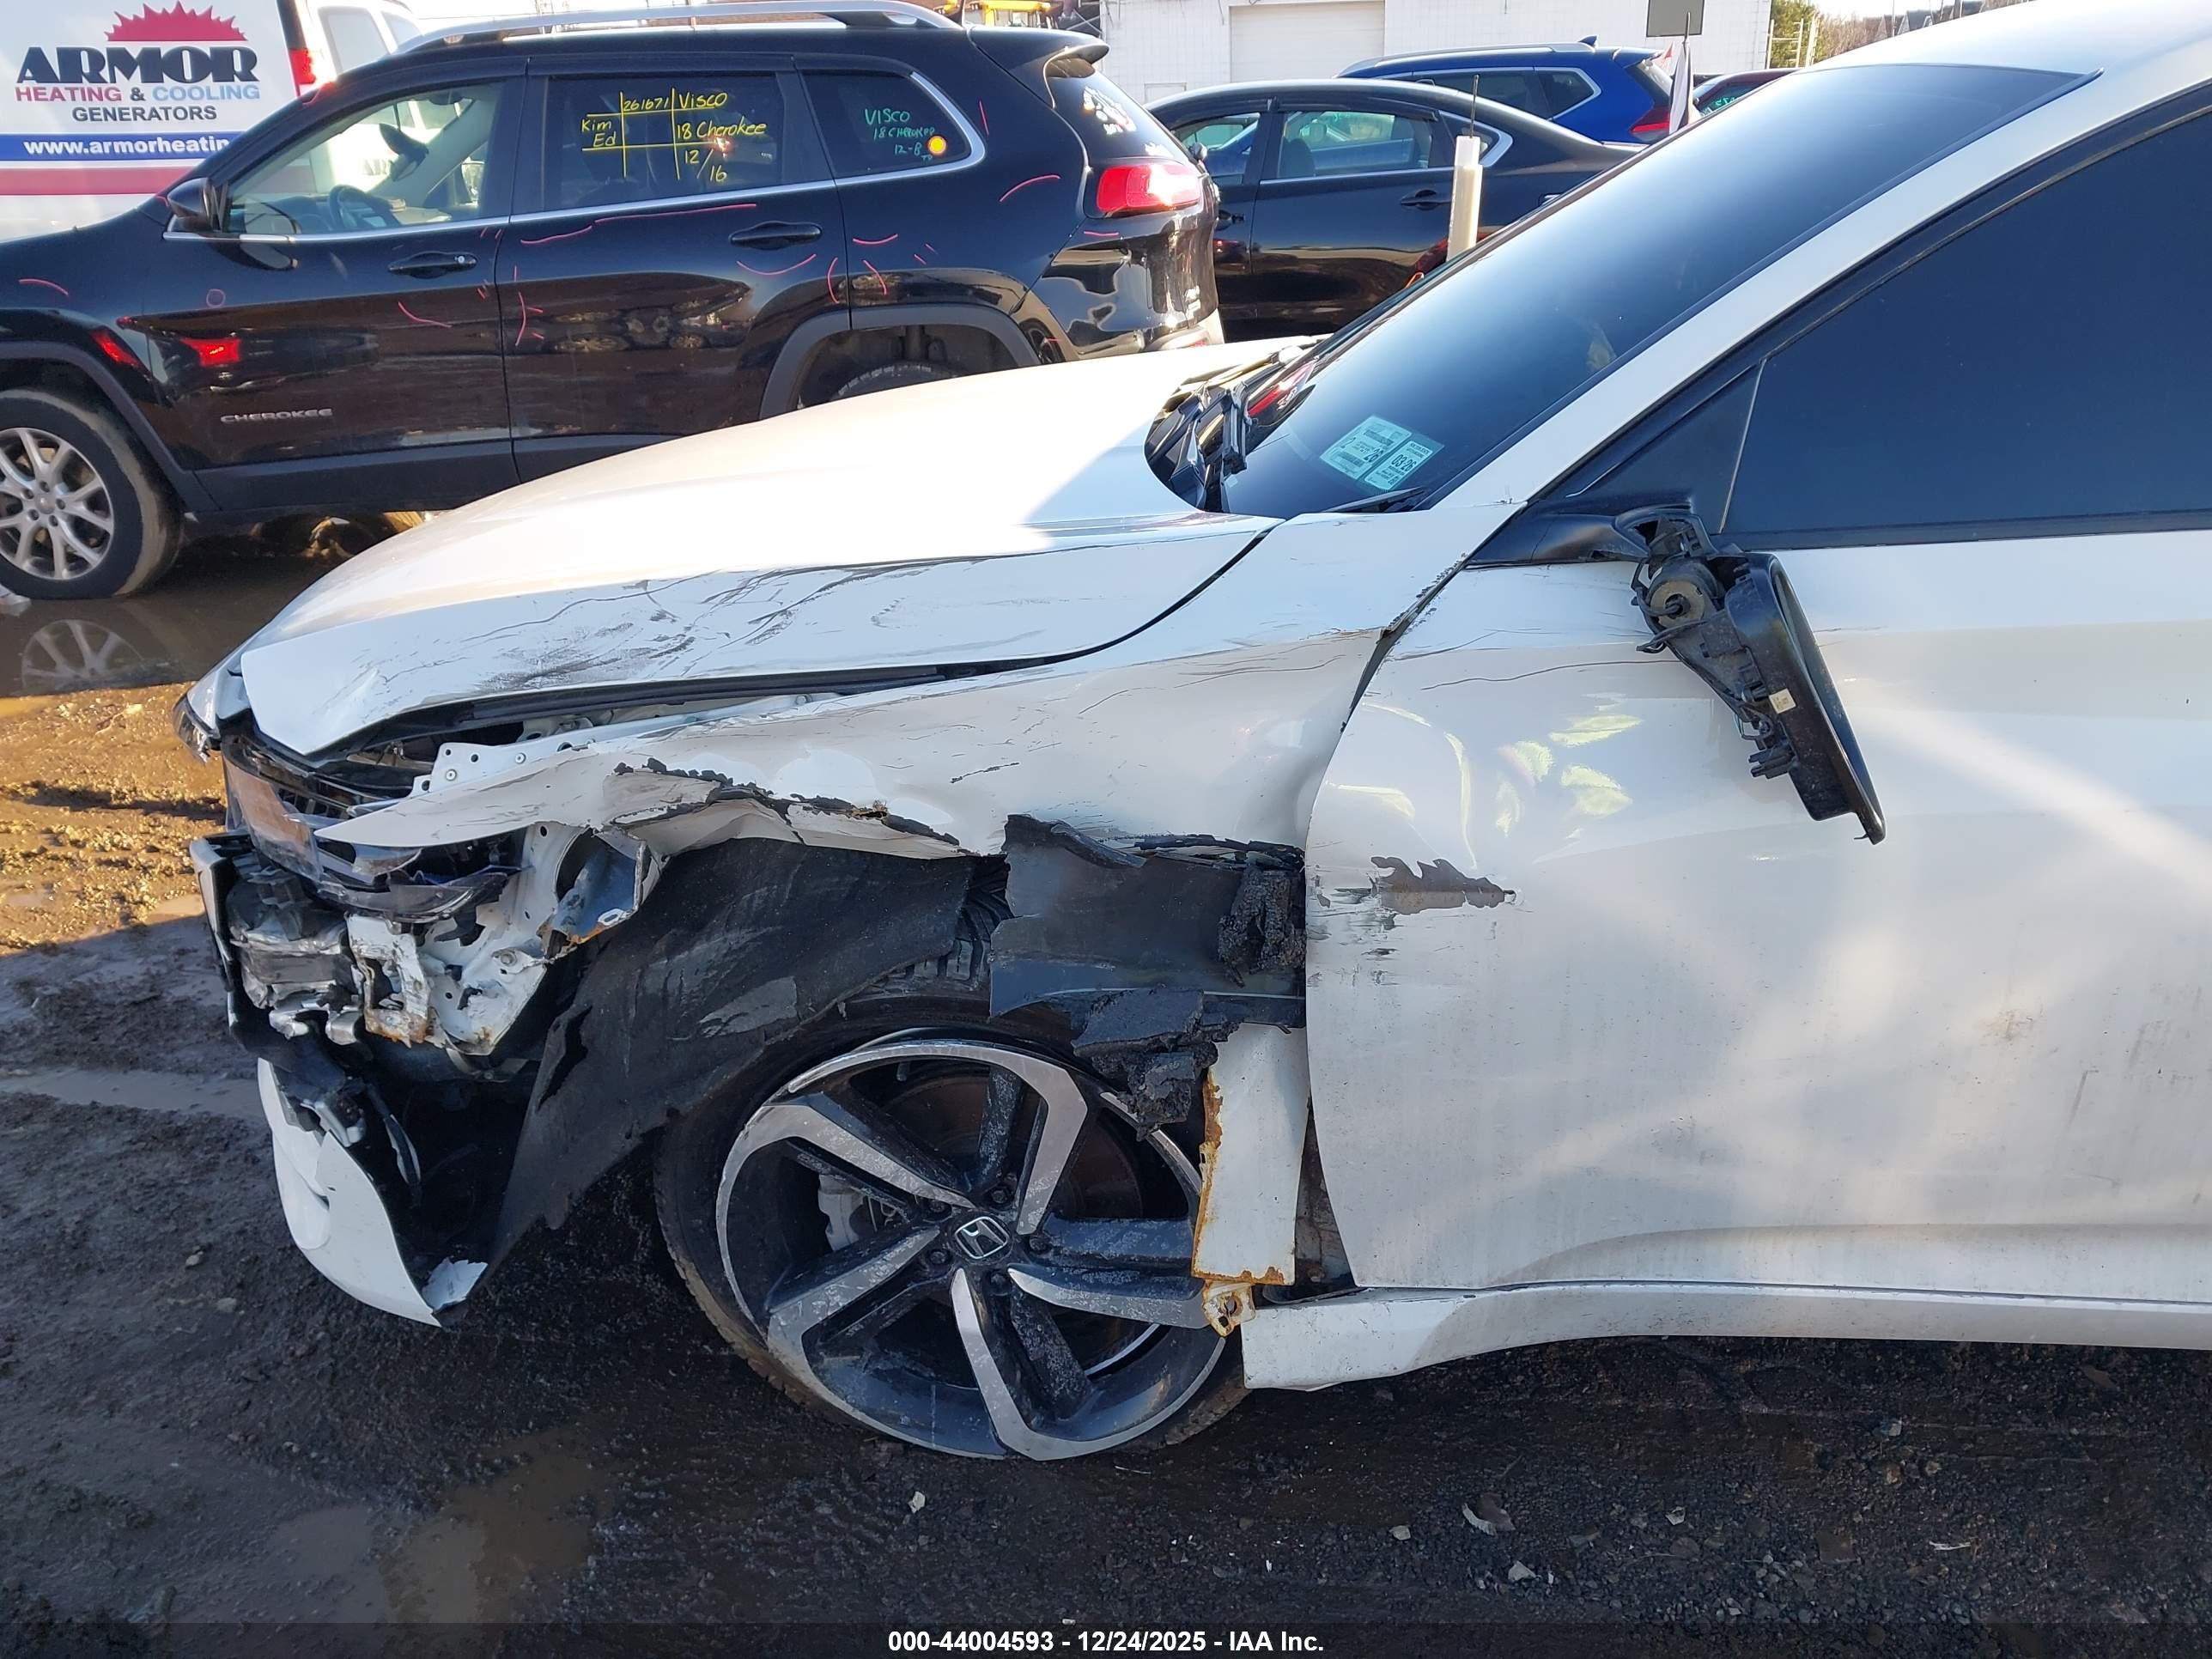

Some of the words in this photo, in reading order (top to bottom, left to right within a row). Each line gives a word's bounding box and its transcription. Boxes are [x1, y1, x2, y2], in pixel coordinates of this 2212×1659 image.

[16, 46, 260, 84] ARMOR
[15, 86, 122, 102] HEATING
[130, 87, 146, 101] &
[152, 85, 260, 101] COOLING
[623, 97, 669, 112] 261671
[72, 105, 217, 122] GENERATORS
[864, 108, 910, 125] VISCO
[581, 118, 611, 132] Kim
[678, 122, 693, 138] 18
[696, 115, 767, 138] Cherokee
[592, 131, 617, 147] Ed
[220, 408, 333, 423] CHEROKEE
